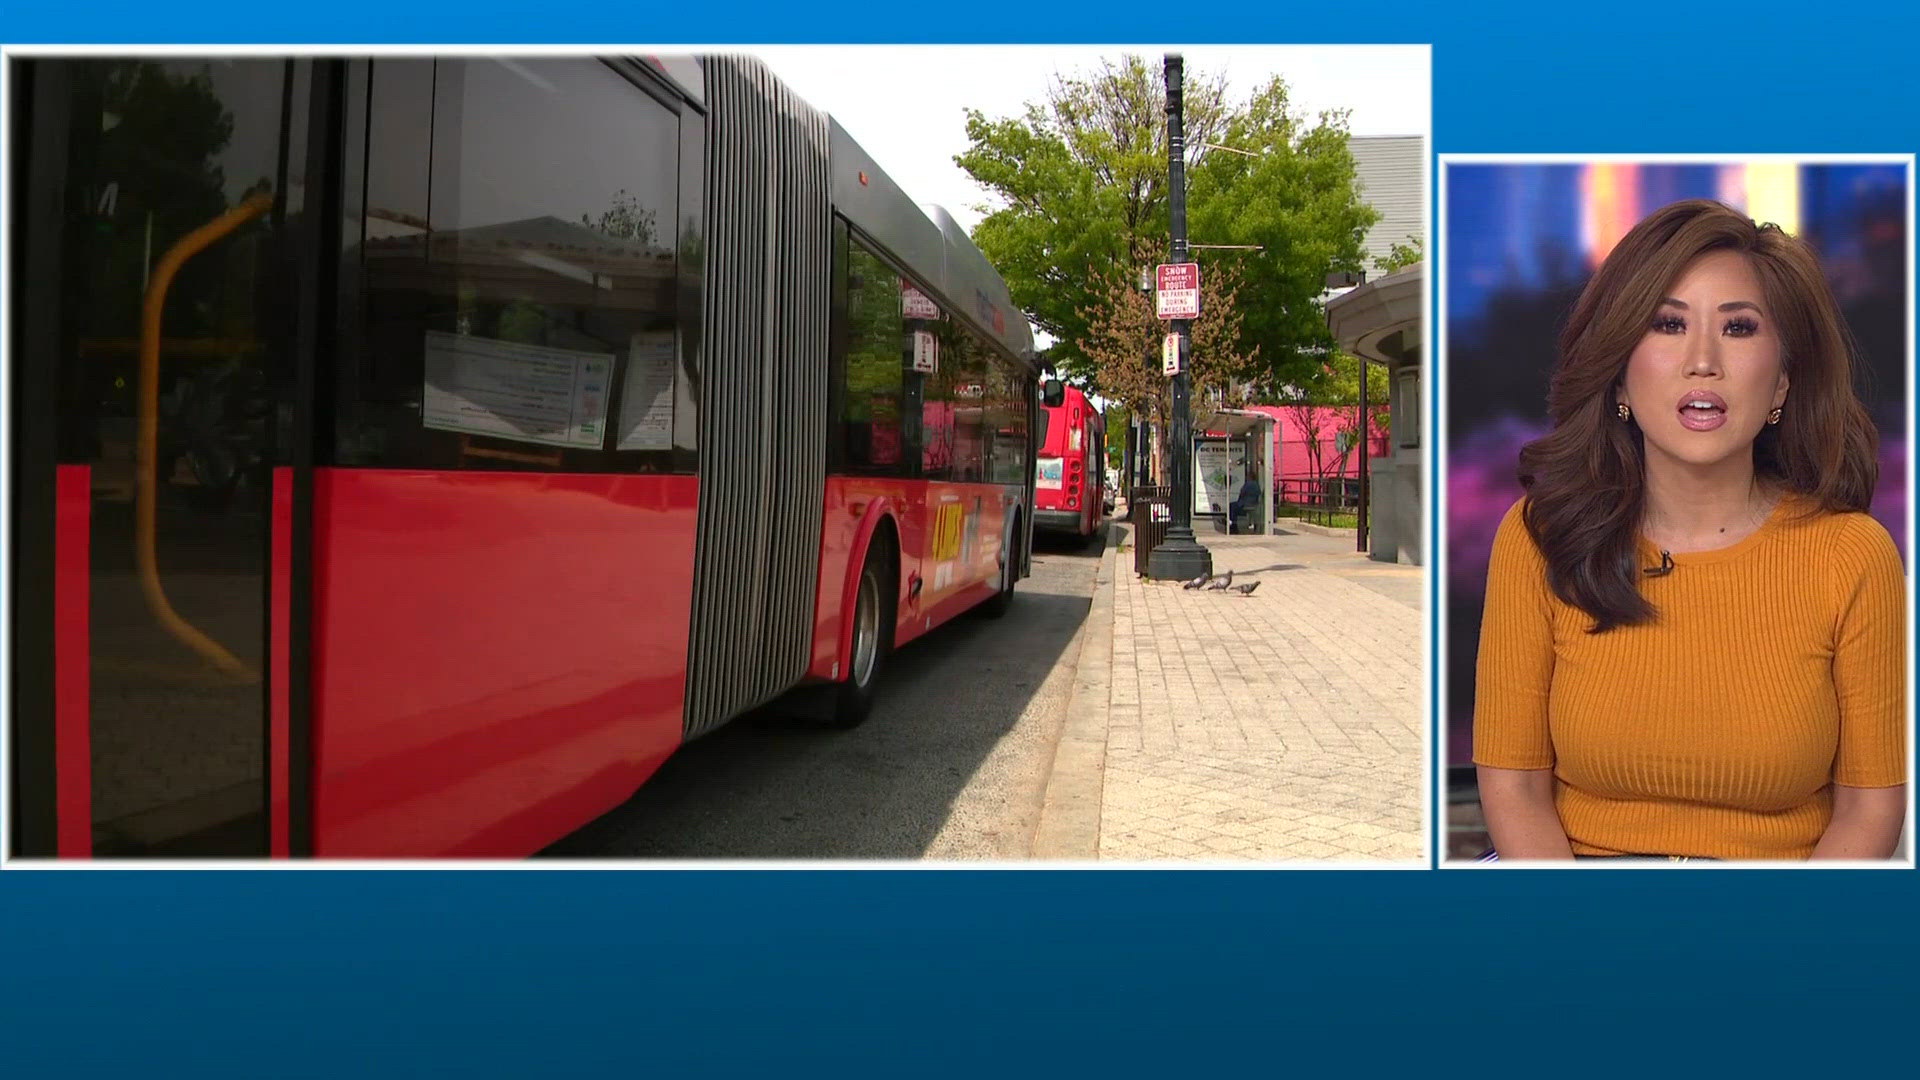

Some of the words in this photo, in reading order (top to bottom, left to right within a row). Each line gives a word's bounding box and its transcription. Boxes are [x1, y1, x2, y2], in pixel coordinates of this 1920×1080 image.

[1165, 267, 1187, 276] SNOW
[1165, 281, 1187, 290] ROUTE
[1165, 298, 1188, 306] DURING
